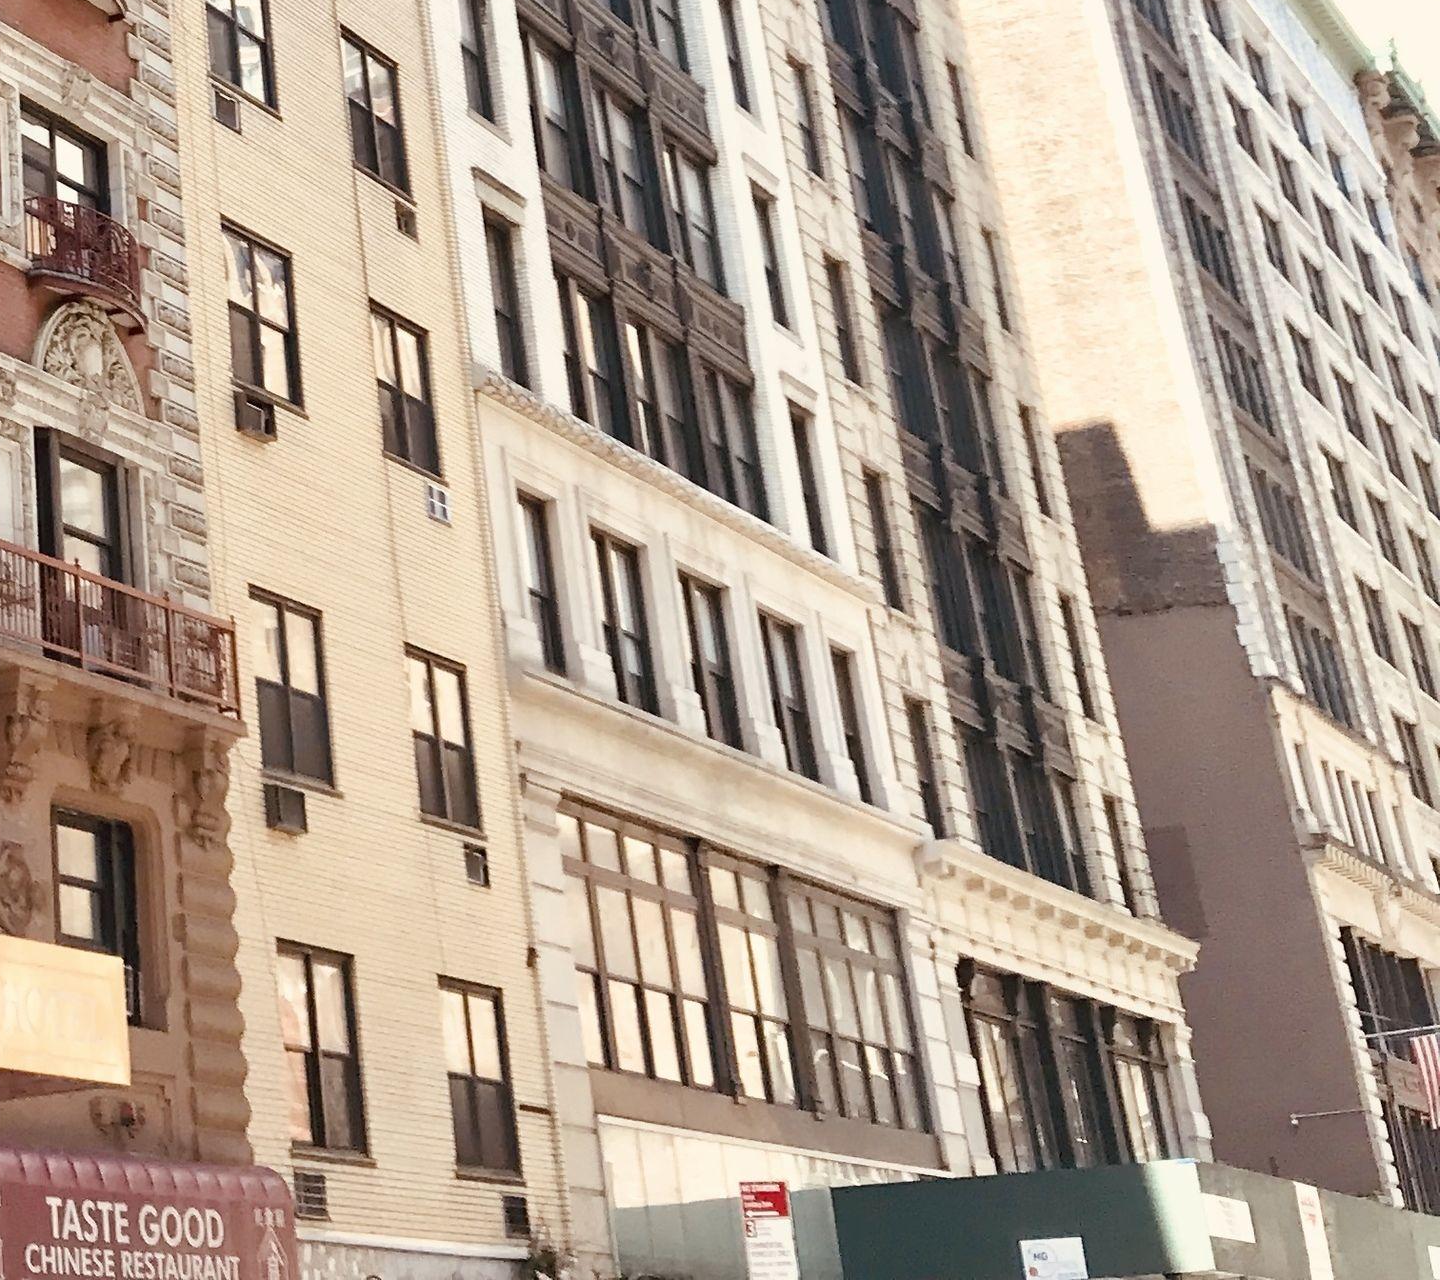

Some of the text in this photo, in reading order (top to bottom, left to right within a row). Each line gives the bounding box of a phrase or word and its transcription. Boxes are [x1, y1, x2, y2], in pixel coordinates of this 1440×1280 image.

[45, 1196, 225, 1249] TASTE GOOD
[24, 1243, 116, 1278] CHINESE
[120, 1250, 241, 1280] RESTAURANT
